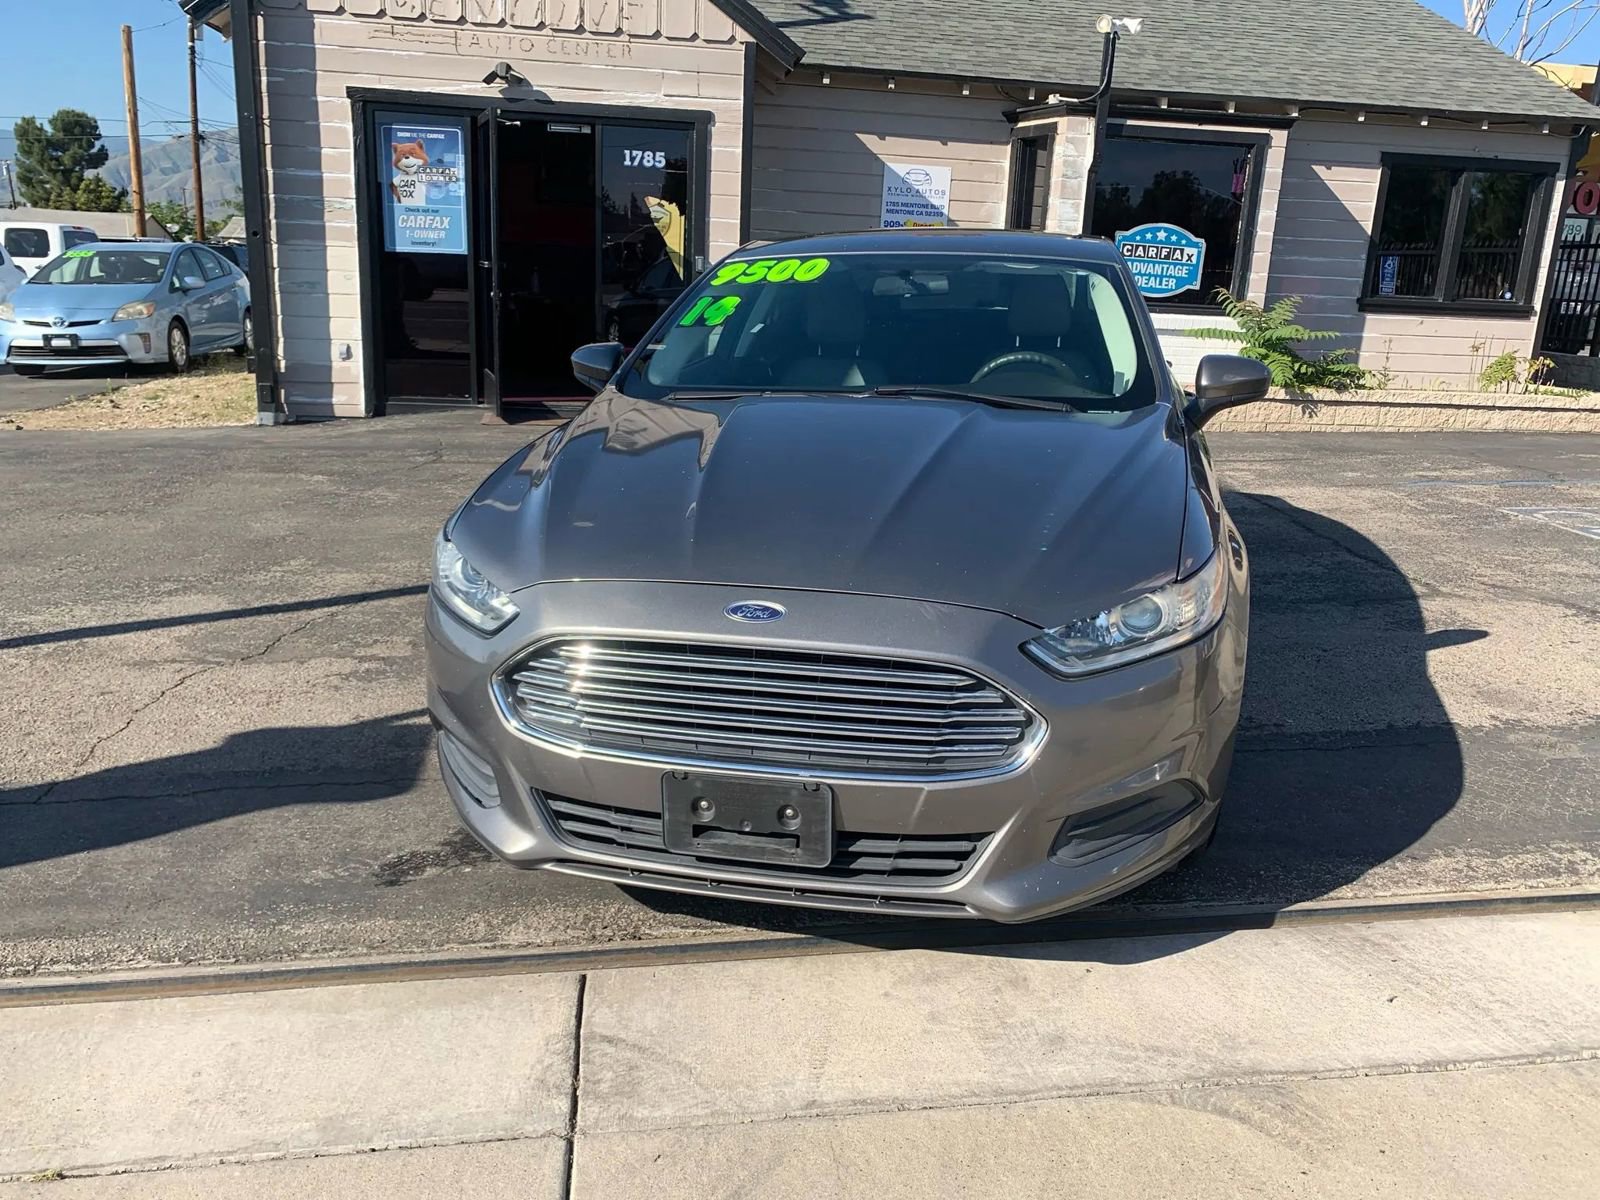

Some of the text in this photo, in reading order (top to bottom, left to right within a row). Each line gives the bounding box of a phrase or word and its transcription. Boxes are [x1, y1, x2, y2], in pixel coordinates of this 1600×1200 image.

[623, 149, 666, 168] 1785
[419, 167, 457, 175] CARFAX
[399, 179, 416, 189] CAR
[887, 186, 912, 194] XYLO
[886, 208, 914, 216] MENTONE
[398, 214, 452, 229] CARFAX
[406, 229, 446, 239] 1-OWNER
[1123, 244, 1194, 263] CARFAX
[710, 258, 830, 286] 9500
[1127, 261, 1189, 277] ADVANTAGE
[1135, 275, 1177, 289] DEALER
[679, 296, 742, 327] 14
[736, 604, 773, 618] Ford
